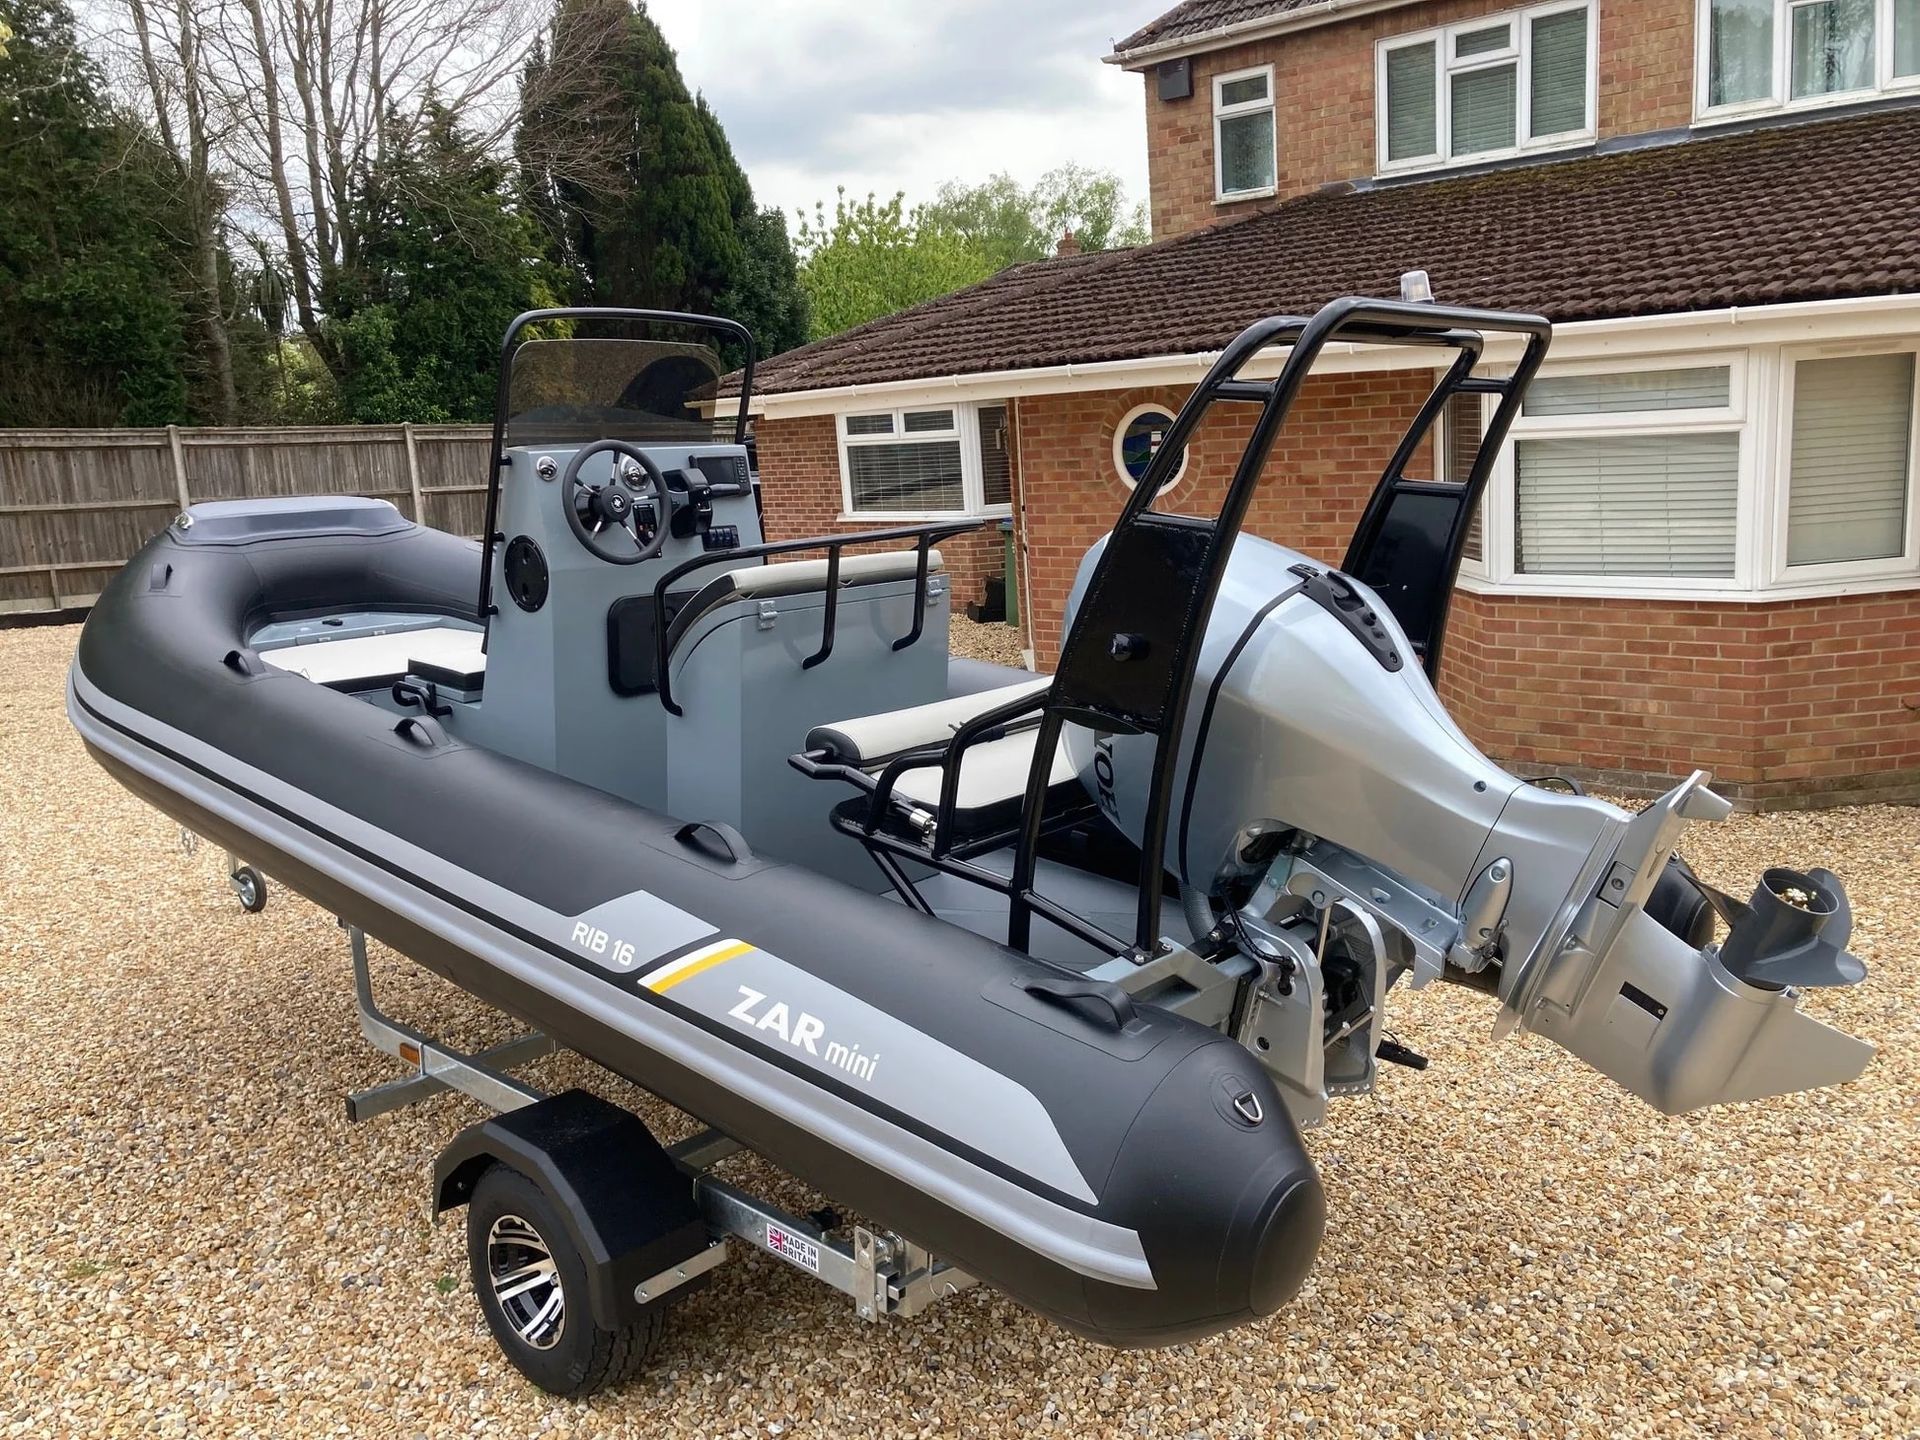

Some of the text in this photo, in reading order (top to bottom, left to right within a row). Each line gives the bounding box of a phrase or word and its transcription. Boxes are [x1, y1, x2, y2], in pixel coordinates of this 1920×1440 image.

[571, 921, 635, 966] RIB 16
[727, 984, 880, 1081] ZAR mini
[782, 1233, 817, 1259] MADE IN
[782, 1244, 817, 1270] BRITAIN
